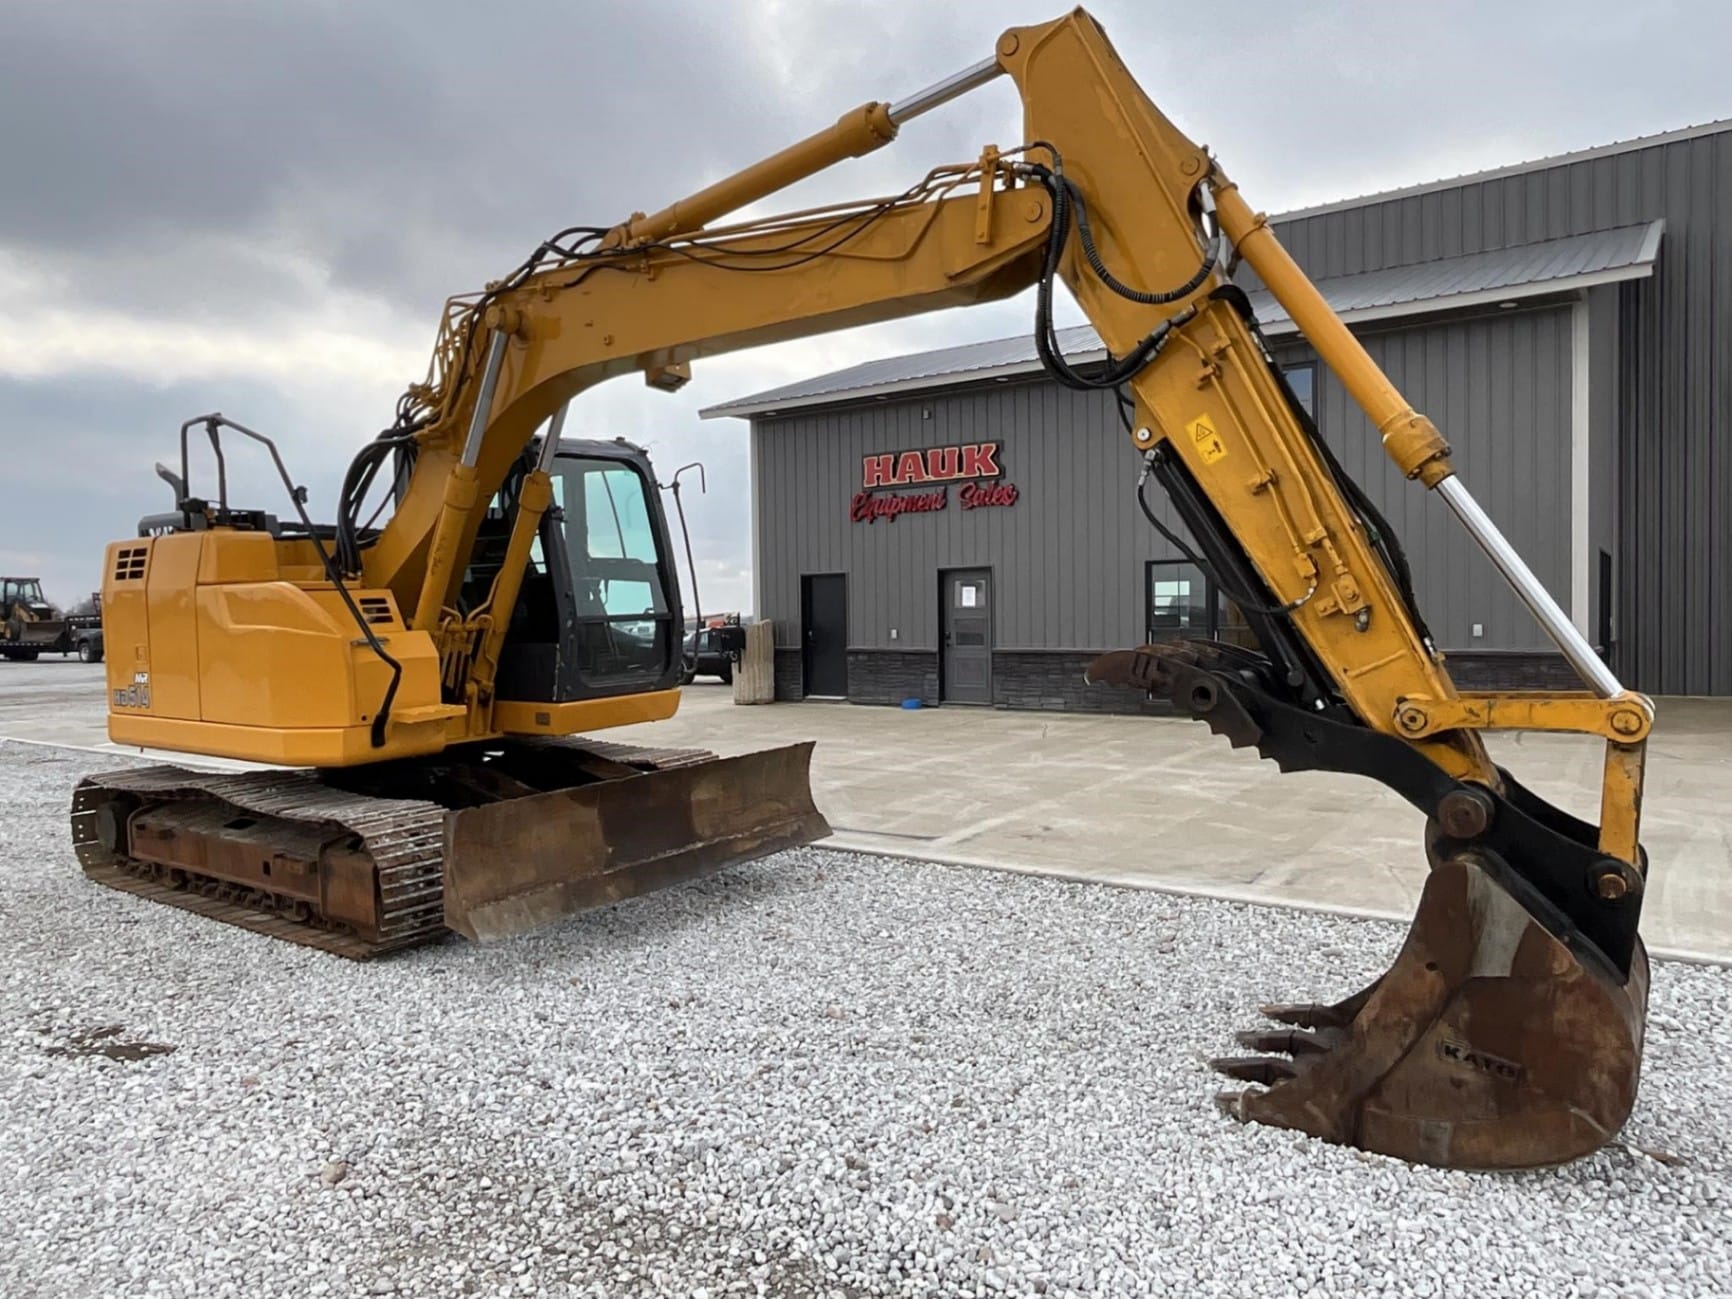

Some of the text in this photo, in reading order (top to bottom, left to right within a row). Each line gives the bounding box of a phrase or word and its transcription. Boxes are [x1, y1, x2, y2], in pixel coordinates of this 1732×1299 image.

[863, 443, 1000, 488] HAUK
[850, 480, 1019, 524] Equipment Sales
